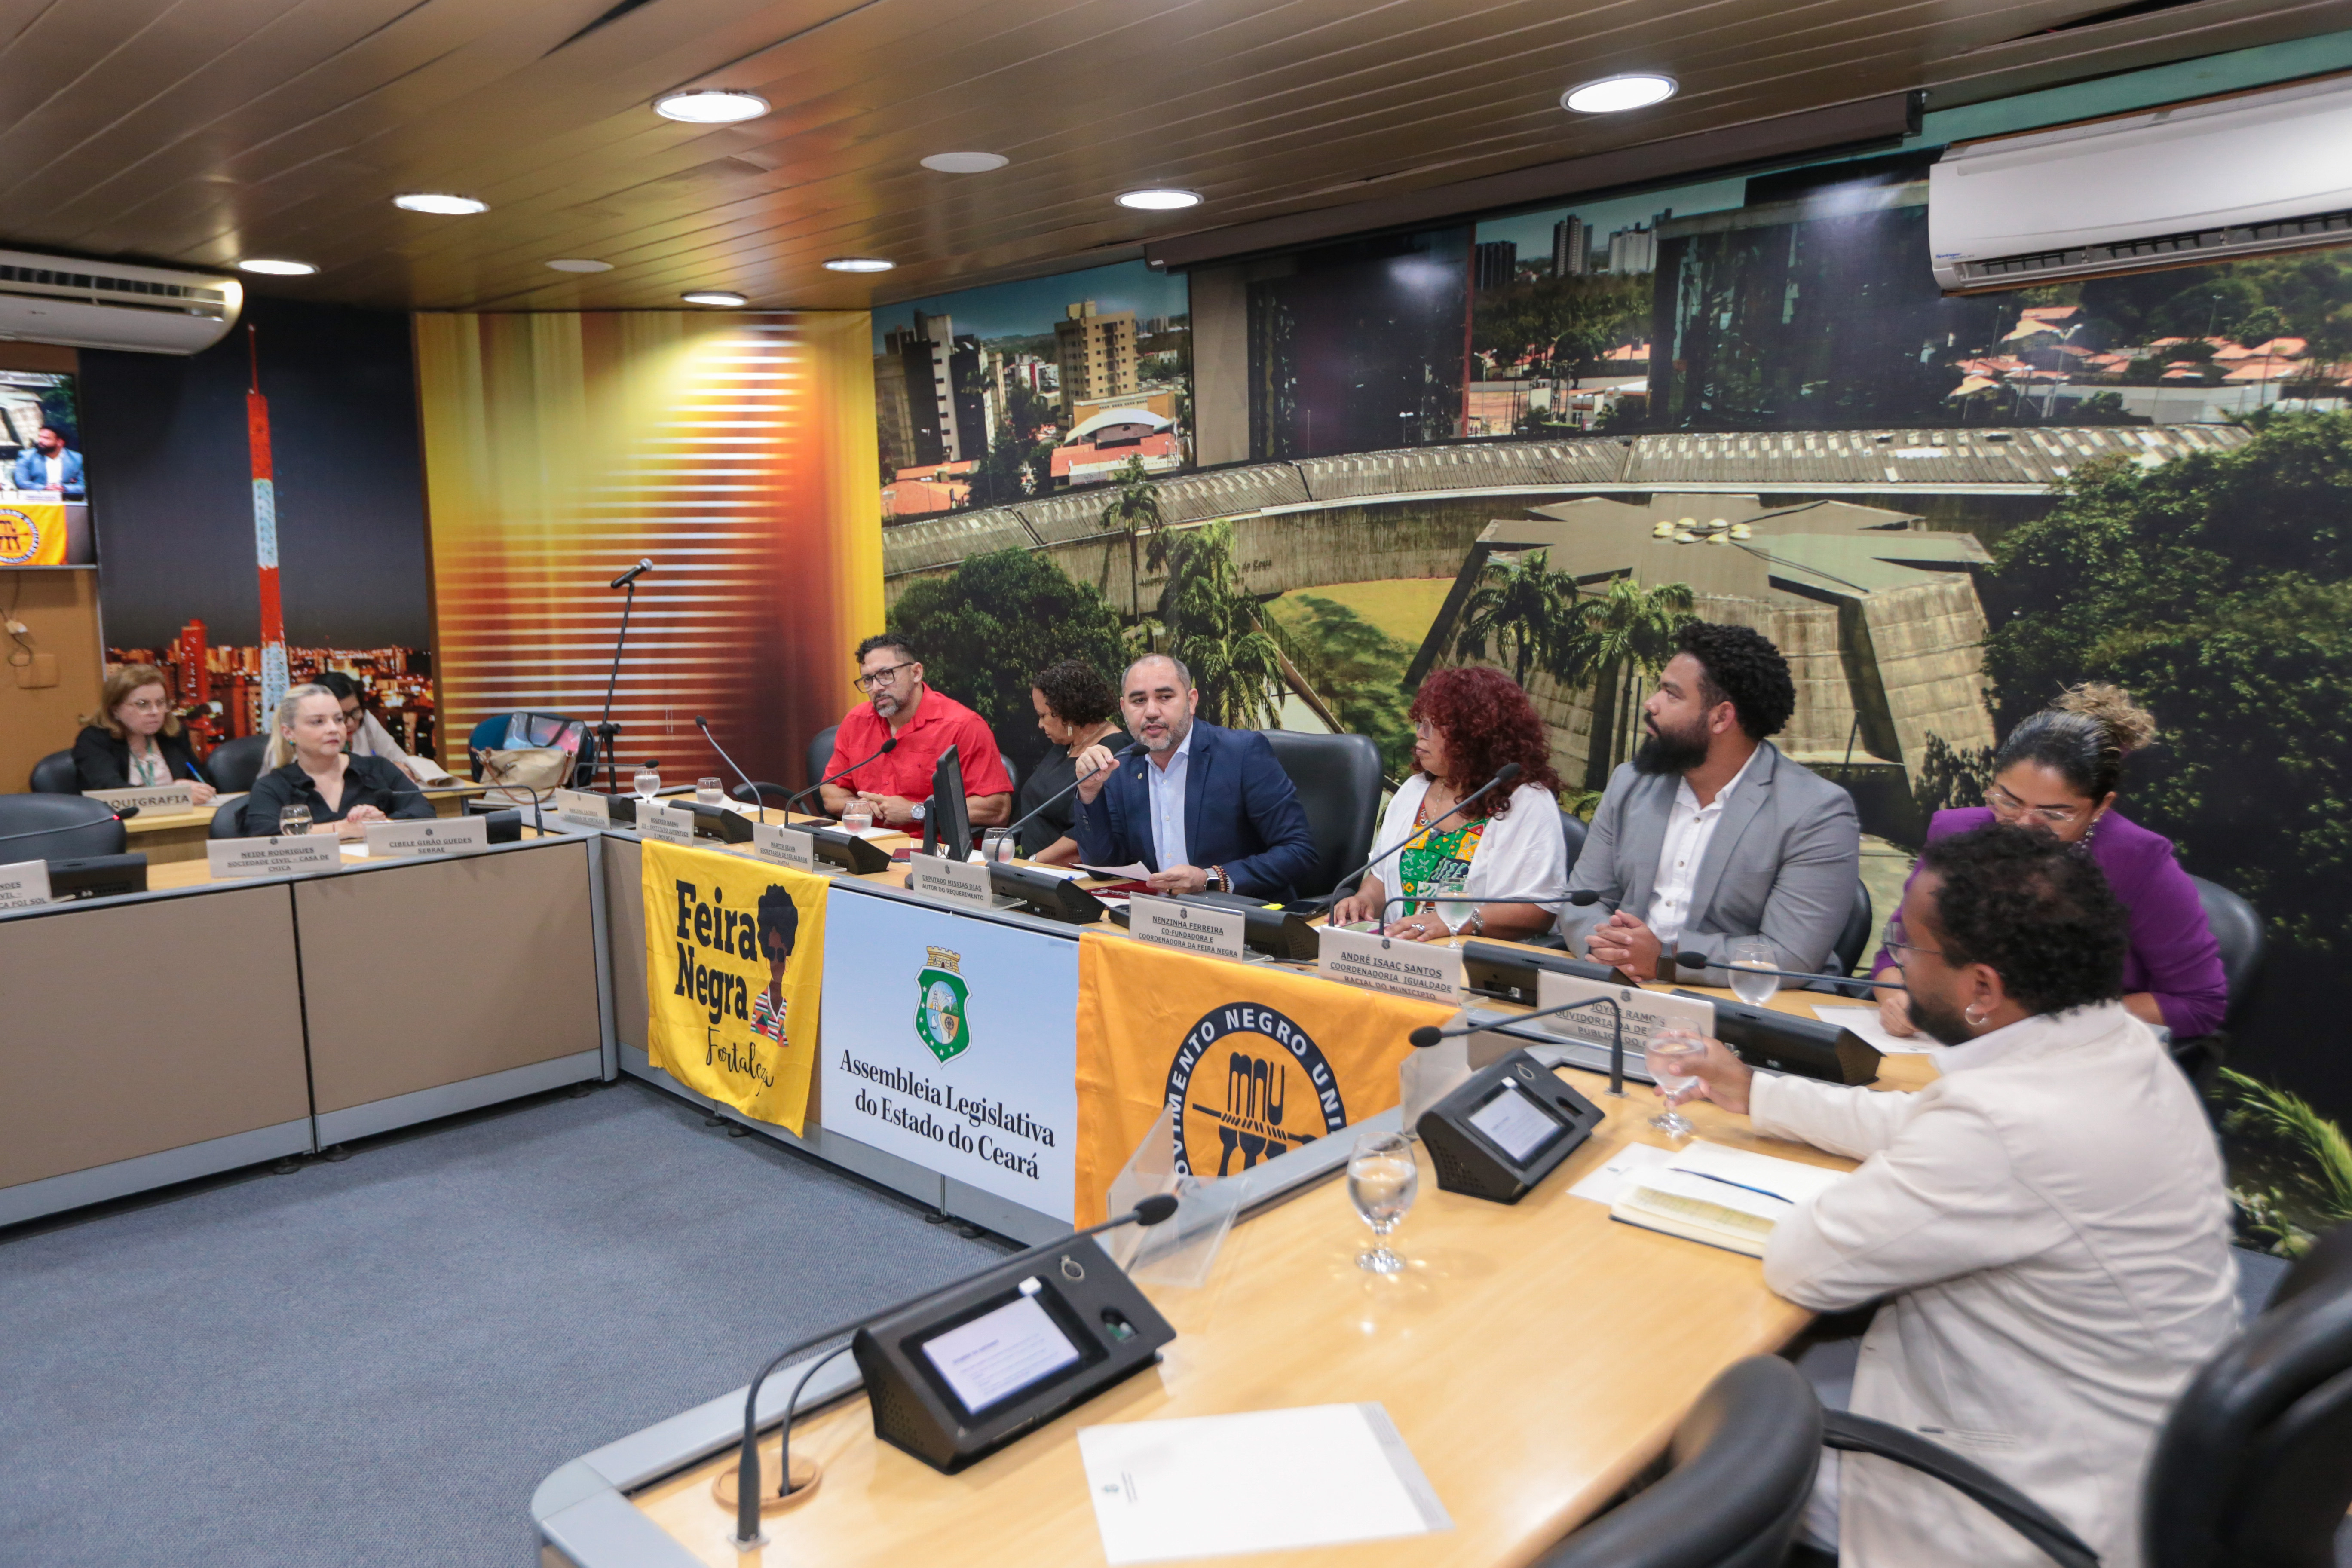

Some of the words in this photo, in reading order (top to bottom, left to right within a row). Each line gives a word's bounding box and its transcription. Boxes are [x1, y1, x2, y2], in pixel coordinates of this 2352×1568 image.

[669, 829, 689, 837] JUVENTUDE
[268, 847, 314, 856] RODRIGUES
[760, 848, 781, 857] SECRETARIA
[787, 853, 808, 862] IGUALDADE
[922, 874, 947, 885] DEPUTADO
[948, 879, 968, 888] MISSIAS
[946, 888, 984, 901] REQUERIMENTO
[676, 879, 758, 962] Feira
[1152, 916, 1187, 928] NENZINHA
[1189, 922, 1224, 934] FERREIRA
[1161, 928, 1208, 942] CO-FUNDADORA
[1139, 932, 1186, 947] COORDENADORA
[1197, 944, 1216, 953] FEIRA
[1217, 948, 1237, 957] NEGRA
[1341, 951, 1370, 964] ANDRÉ
[1373, 957, 1402, 970] ISAAC
[1404, 964, 1442, 977] SANTOS
[674, 941, 749, 1025] Negra
[1330, 962, 1399, 982] COORDENADORIA
[1403, 976, 1452, 992] IGUALDADE
[1344, 976, 1372, 986] RACIAL
[1555, 1010, 1613, 1028] OUVIDORIA
[1578, 1025, 1615, 1040] PÚBLIC
[706, 1026, 774, 1097] Fortaleza
[839, 1049, 942, 1107] Assembleia
[945, 1084, 1056, 1148] Legislativa
[1169, 1021, 1215, 1178] OVIMENTO
[1225, 1008, 1307, 1056] NEGRO
[855, 1088, 877, 1116] do
[881, 1096, 944, 1142] Estado
[948, 1123, 974, 1154] do
[978, 1134, 1040, 1180] Ceará
